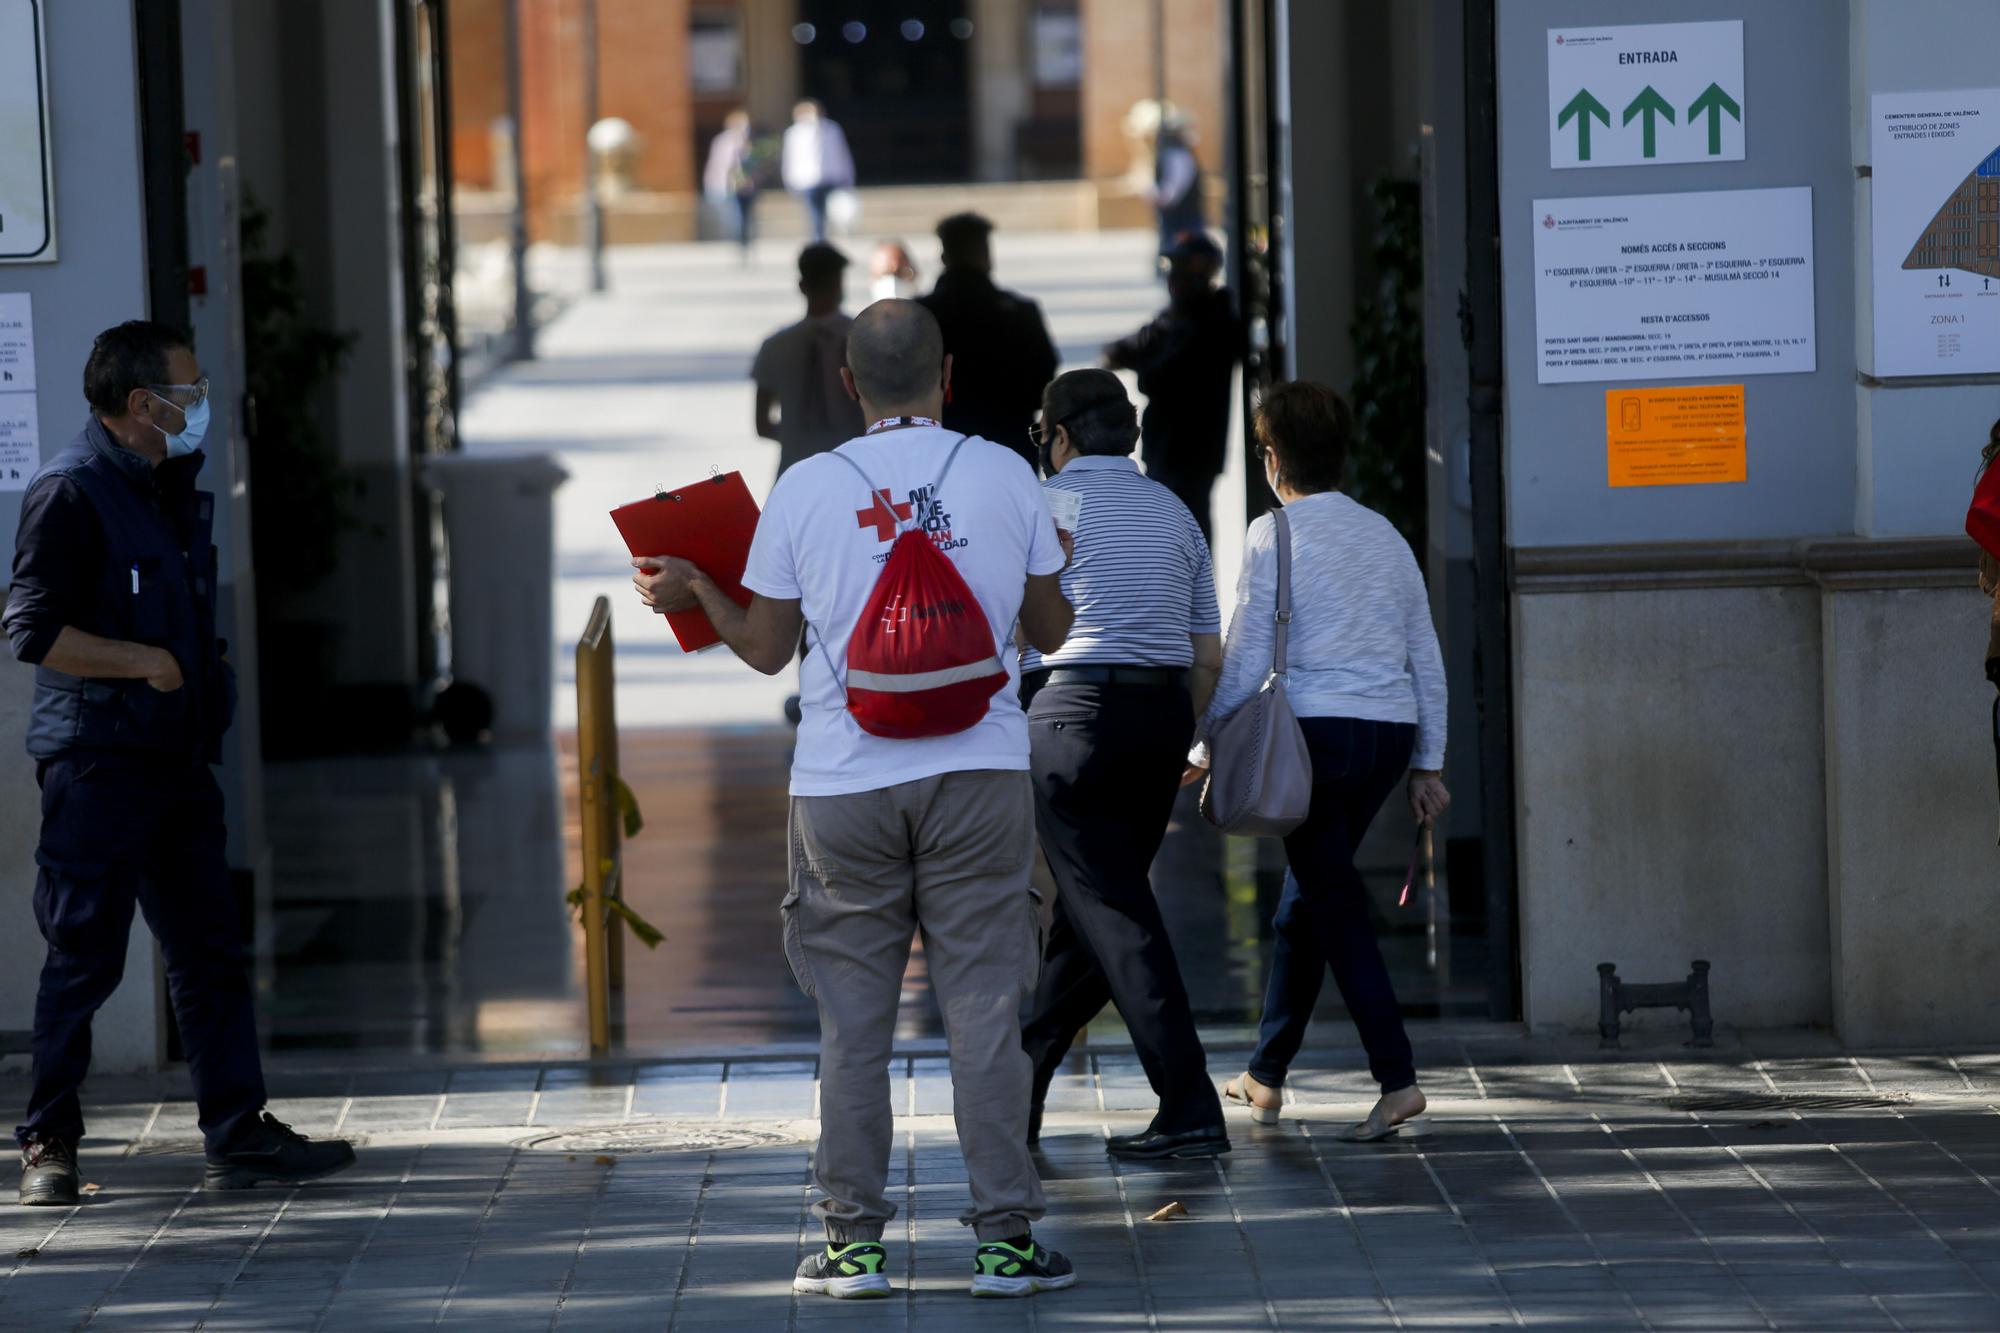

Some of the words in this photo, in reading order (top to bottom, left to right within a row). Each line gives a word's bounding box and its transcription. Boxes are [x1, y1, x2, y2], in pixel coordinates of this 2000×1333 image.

[1618, 50, 1678, 65] ENTRADA
[1888, 123, 1928, 132] DISTRIBUCIÓ
[1621, 244, 1649, 254] NOMÉS
[1652, 243, 1677, 253] ACCÉS
[1680, 243, 1685, 251] A
[1687, 241, 1726, 251] SECCIONS
[1554, 267, 1589, 276] ESQUERRA
[1595, 266, 1617, 274] DRETA
[1634, 264, 1670, 273] ESQUERRA
[1676, 262, 1699, 271] DRETA
[1715, 260, 1752, 269] ESQUERRA
[1769, 257, 1805, 266] ESQUERRA
[1580, 278, 1617, 288] ESQUERRA
[1743, 270, 1768, 280] SECCIÓ
[1771, 270, 1779, 278] 14
[1641, 315, 1665, 324] RESTA
[1931, 315, 1958, 324] ZONA
[4, 371, 13, 381] h
[11, 468, 20, 479] h
